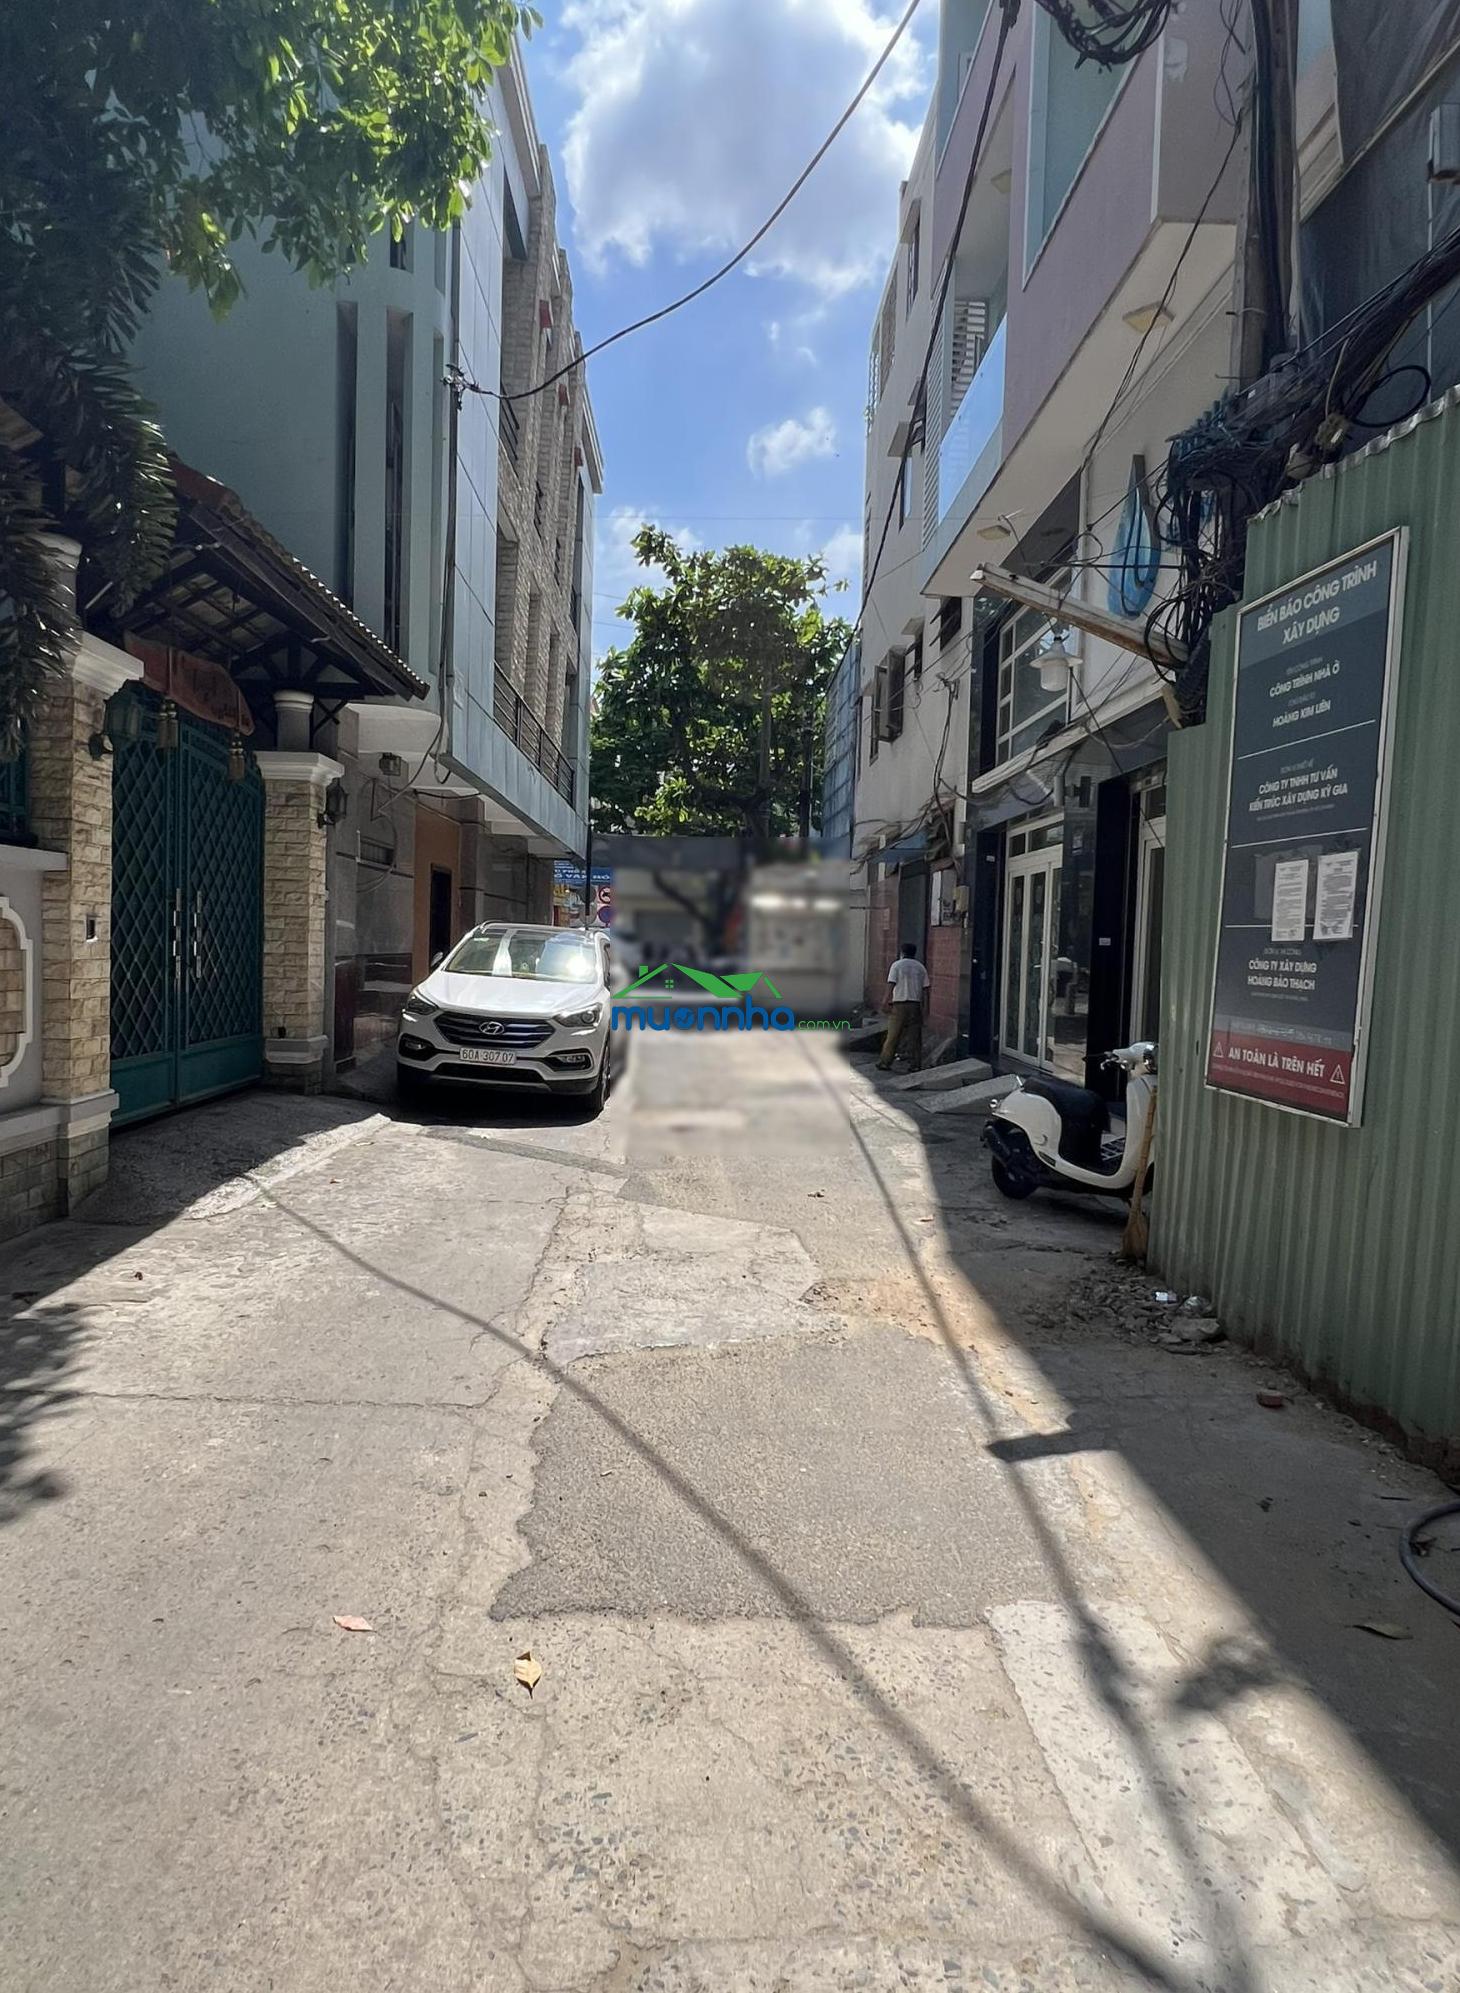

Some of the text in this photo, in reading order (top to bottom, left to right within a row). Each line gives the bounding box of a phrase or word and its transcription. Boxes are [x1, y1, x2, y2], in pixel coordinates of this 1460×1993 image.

[1258, 603, 1279, 631] BIỂN
[1303, 585, 1340, 609] CÔNG
[1342, 560, 1377, 591] TRÌNH
[1282, 621, 1305, 645] XÂY
[1269, 681, 1291, 697] CÔNG
[1259, 780, 1279, 794] CÔNG
[1248, 957, 1270, 970] CÔNG
[1228, 1047, 1326, 1077] AN TOÀN LÀ TRÊN HẾT
